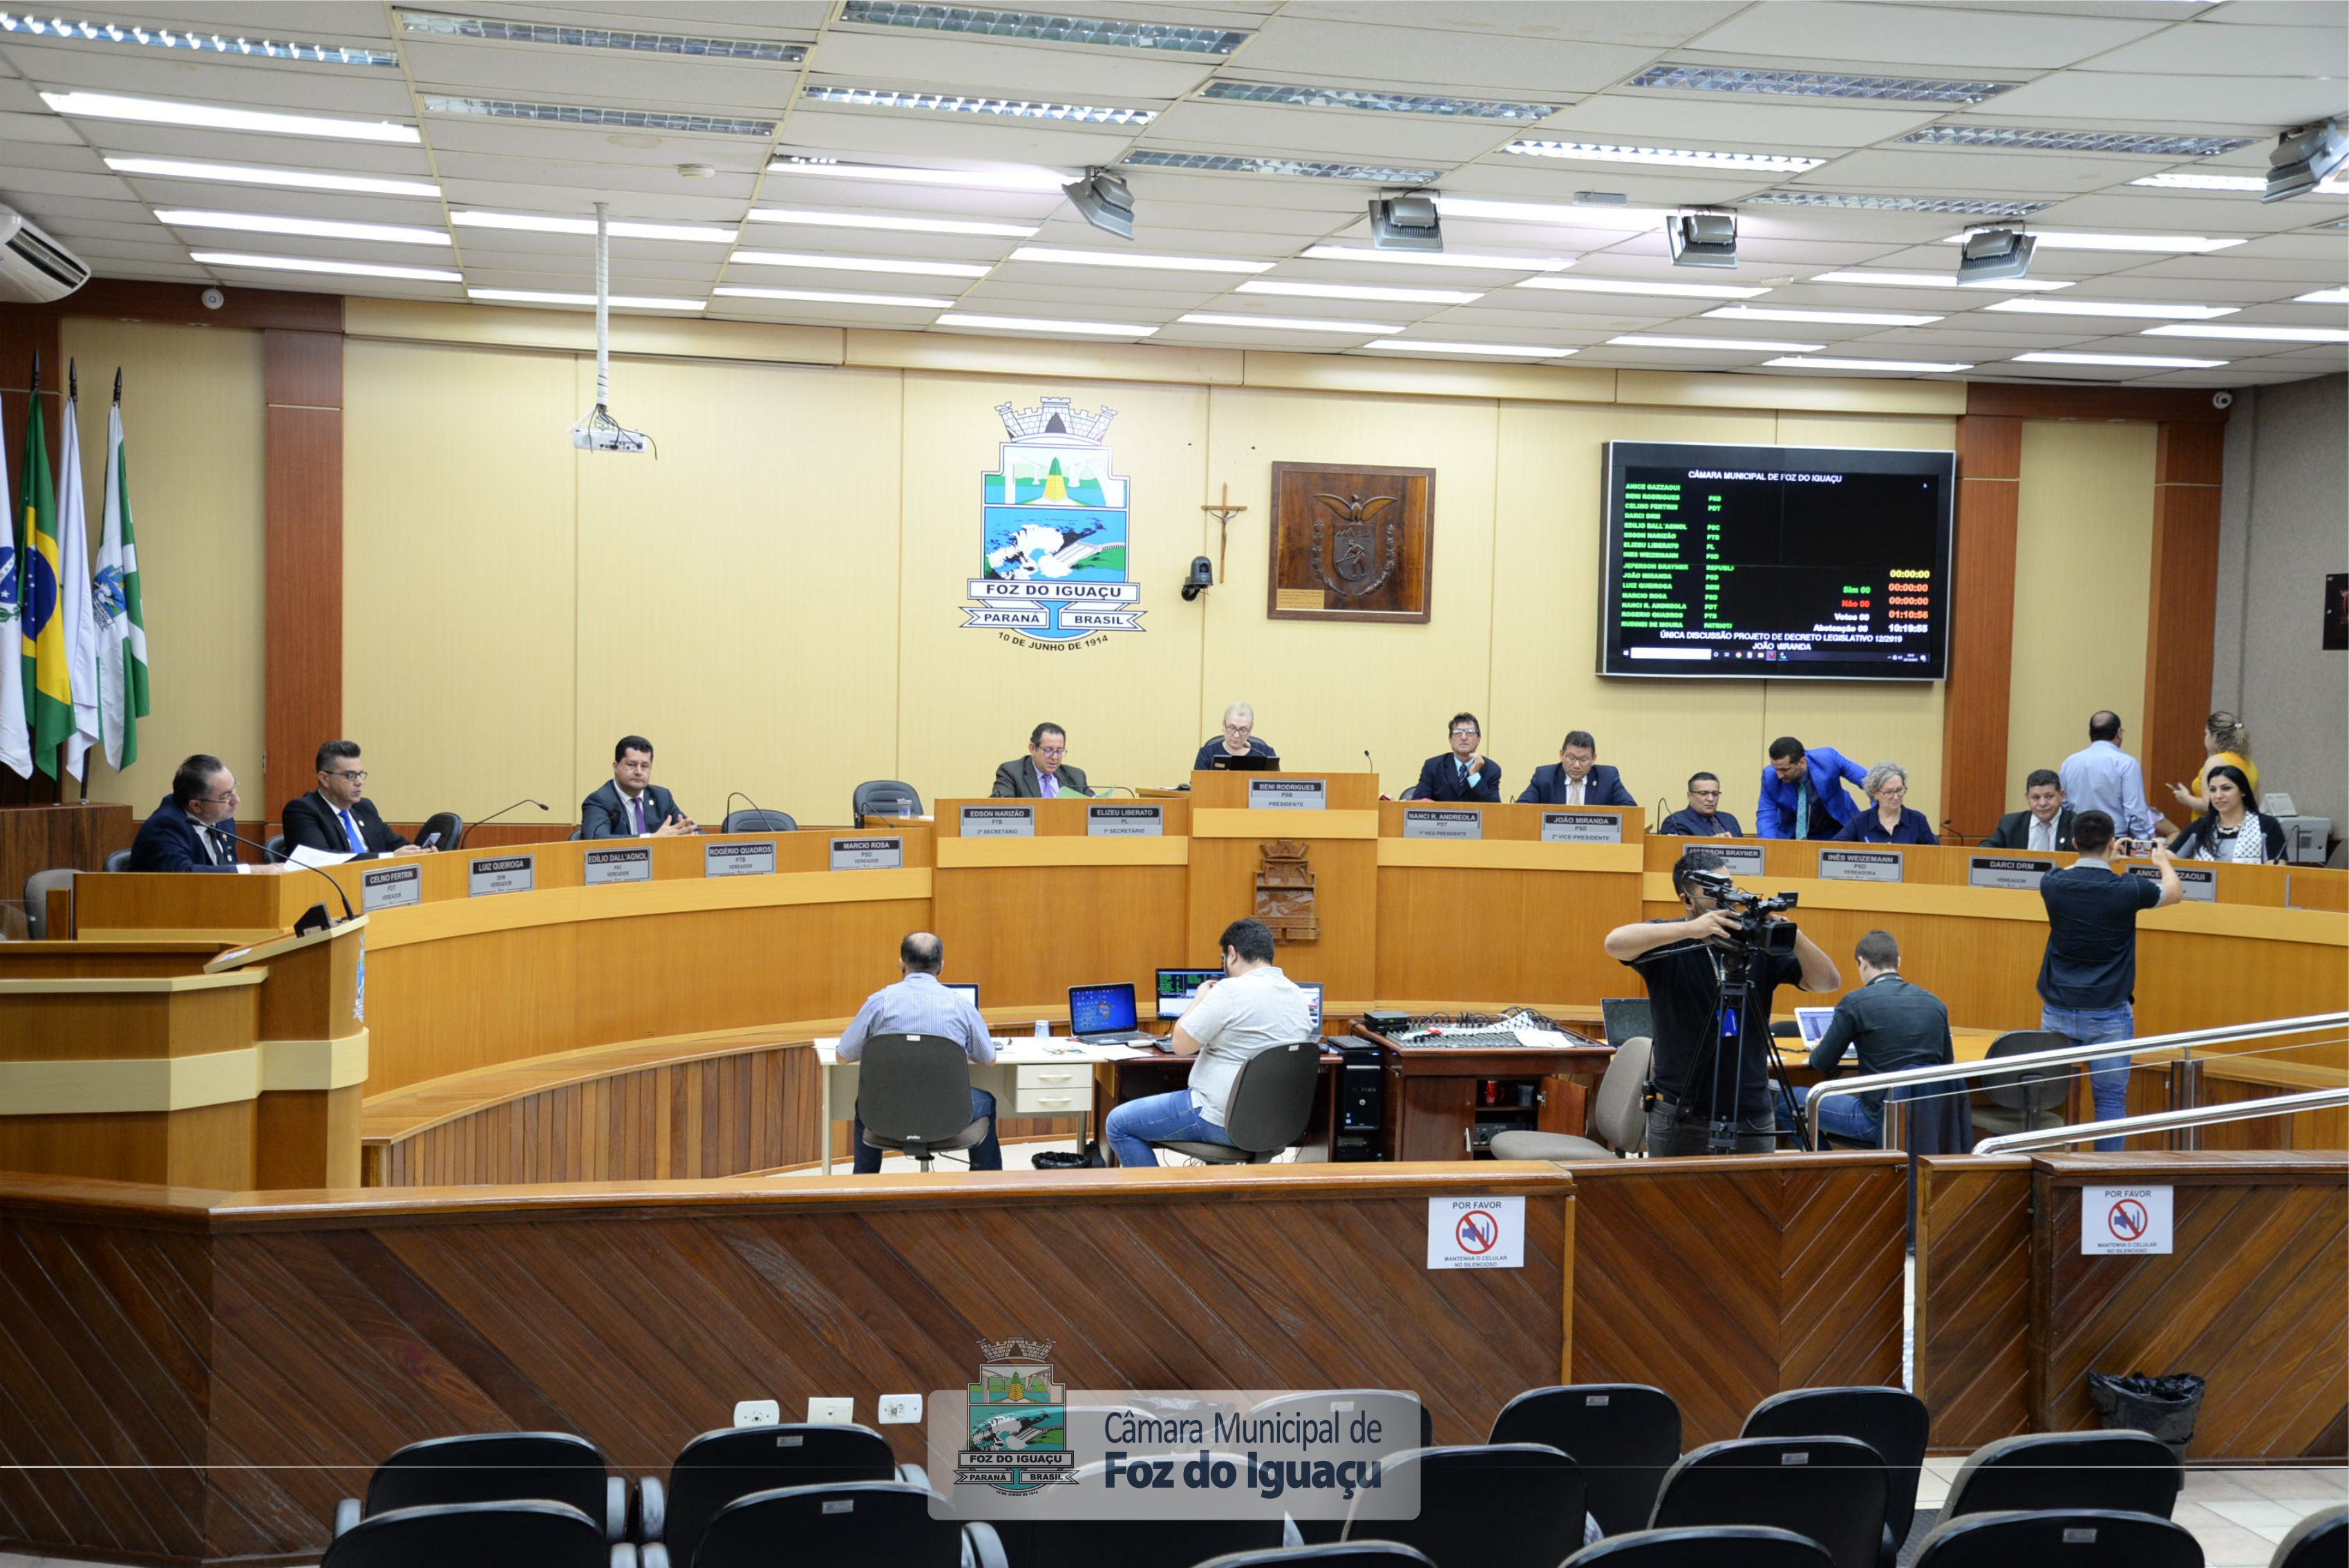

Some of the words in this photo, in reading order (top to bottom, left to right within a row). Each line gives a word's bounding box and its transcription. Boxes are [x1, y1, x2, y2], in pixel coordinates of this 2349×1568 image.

[1688, 470, 1722, 479] CÂMARA
[1724, 472, 1766, 480] MUNICIPAL
[1812, 475, 1842, 484] IGUAÇU
[1889, 569, 1930, 578] 00:00:00
[986, 584, 1020, 595] FOZ
[1026, 585, 1049, 596] DO
[1056, 585, 1122, 601] IGUAÇU
[1888, 583, 1928, 592] 00:00:00
[1889, 597, 1929, 605] 00:00:00
[984, 612, 1040, 623] PARANÁ
[1075, 615, 1124, 625] BRASIL
[1889, 610, 1928, 618] 01:10:56
[1813, 624, 1856, 633] Abstenção
[1660, 630, 1685, 639] ÚNICA
[1686, 630, 1732, 640] DISCUSSÃO
[999, 632, 1010, 641] 10
[1012, 637, 1026, 647] DE
[1028, 642, 1065, 651] JUNHO
[1084, 634, 1109, 648] 1914
[1752, 642, 1774, 650] JOÃO
[709, 846, 739, 856] ROGÉRIO
[740, 846, 771, 854] QUADROS
[588, 854, 609, 863] EDÍLIO
[610, 853, 648, 862] DALL'AGNOL
[478, 862, 492, 871] LUIZ
[492, 860, 524, 871] QUEIROGA
[370, 874, 390, 884] CELINO
[391, 871, 413, 880] FERTRIN
